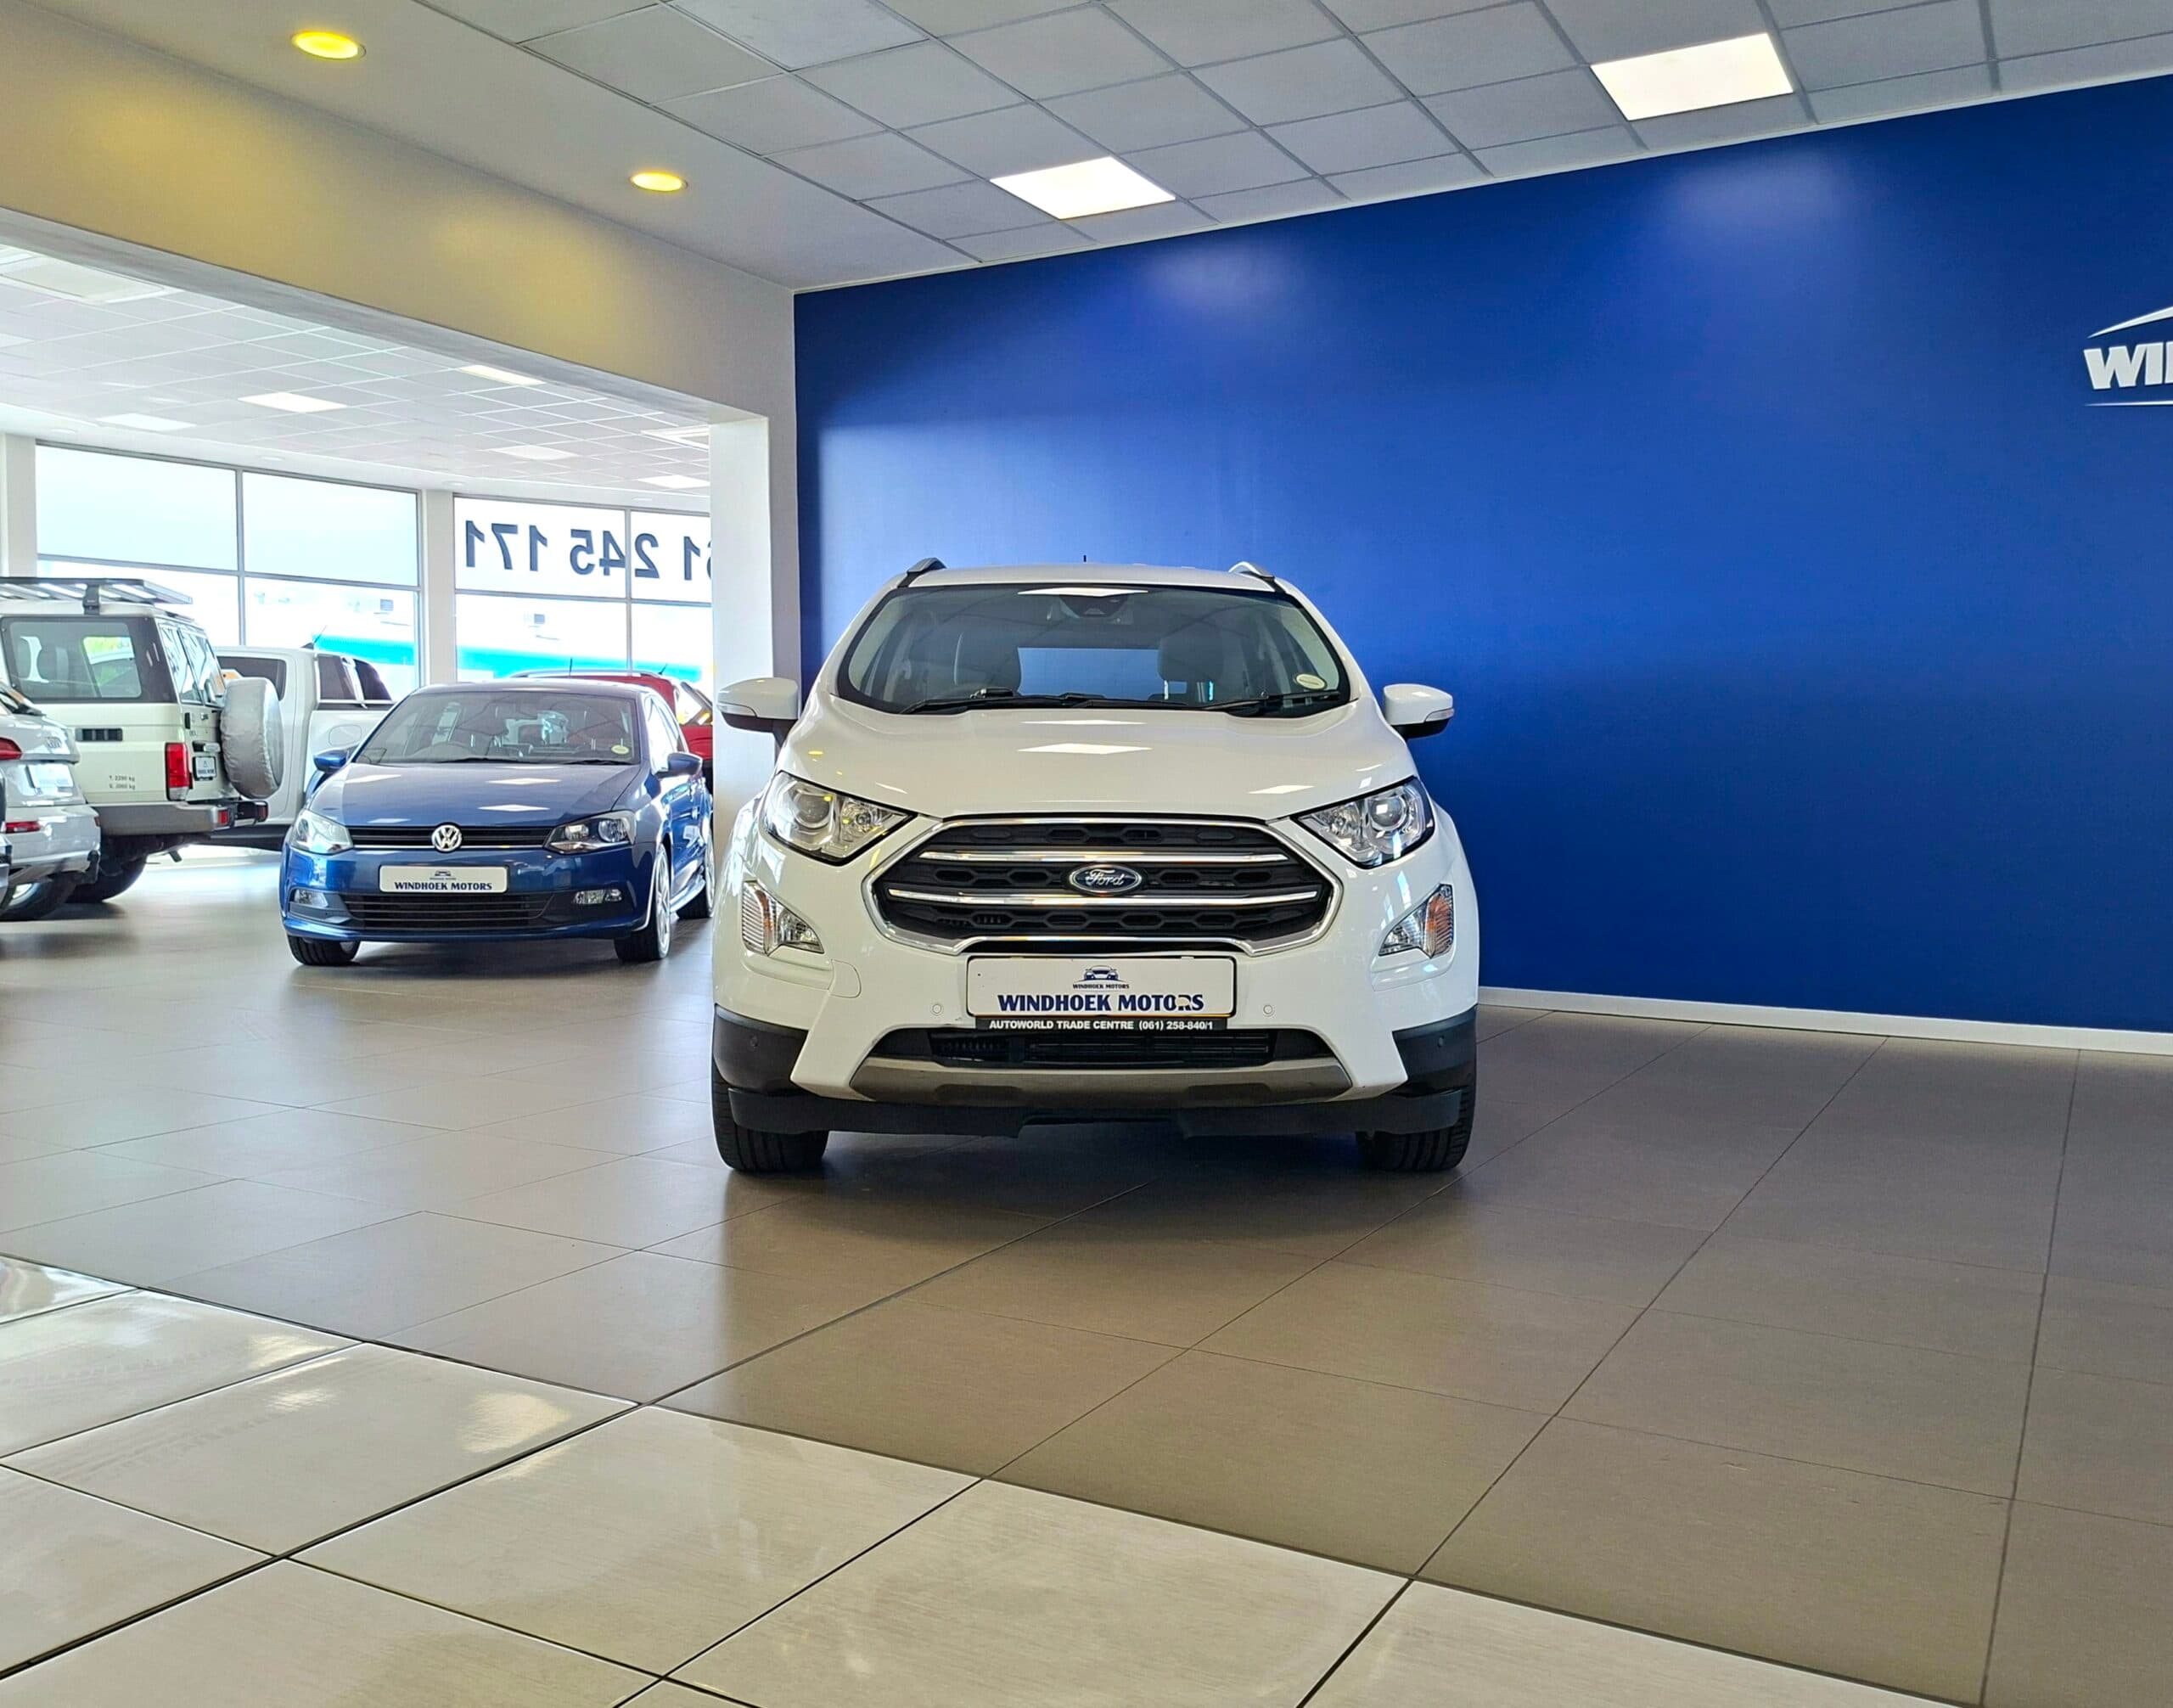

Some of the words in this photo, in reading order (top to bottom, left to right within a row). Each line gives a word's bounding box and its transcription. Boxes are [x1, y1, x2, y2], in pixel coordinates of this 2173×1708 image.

[2084, 341, 2173, 390] WI
[1085, 868, 1125, 886] Ford
[394, 882, 448, 891] WINDHOEK
[451, 882, 492, 891] MOTORS
[997, 994, 1111, 1012] WINDHOEK
[989, 1020, 1054, 1030] AUTOWORLD
[1056, 1020, 1091, 1030] TRADE
[1092, 1020, 1134, 1030] CENTRE
[1138, 1020, 1164, 1031] (061)
